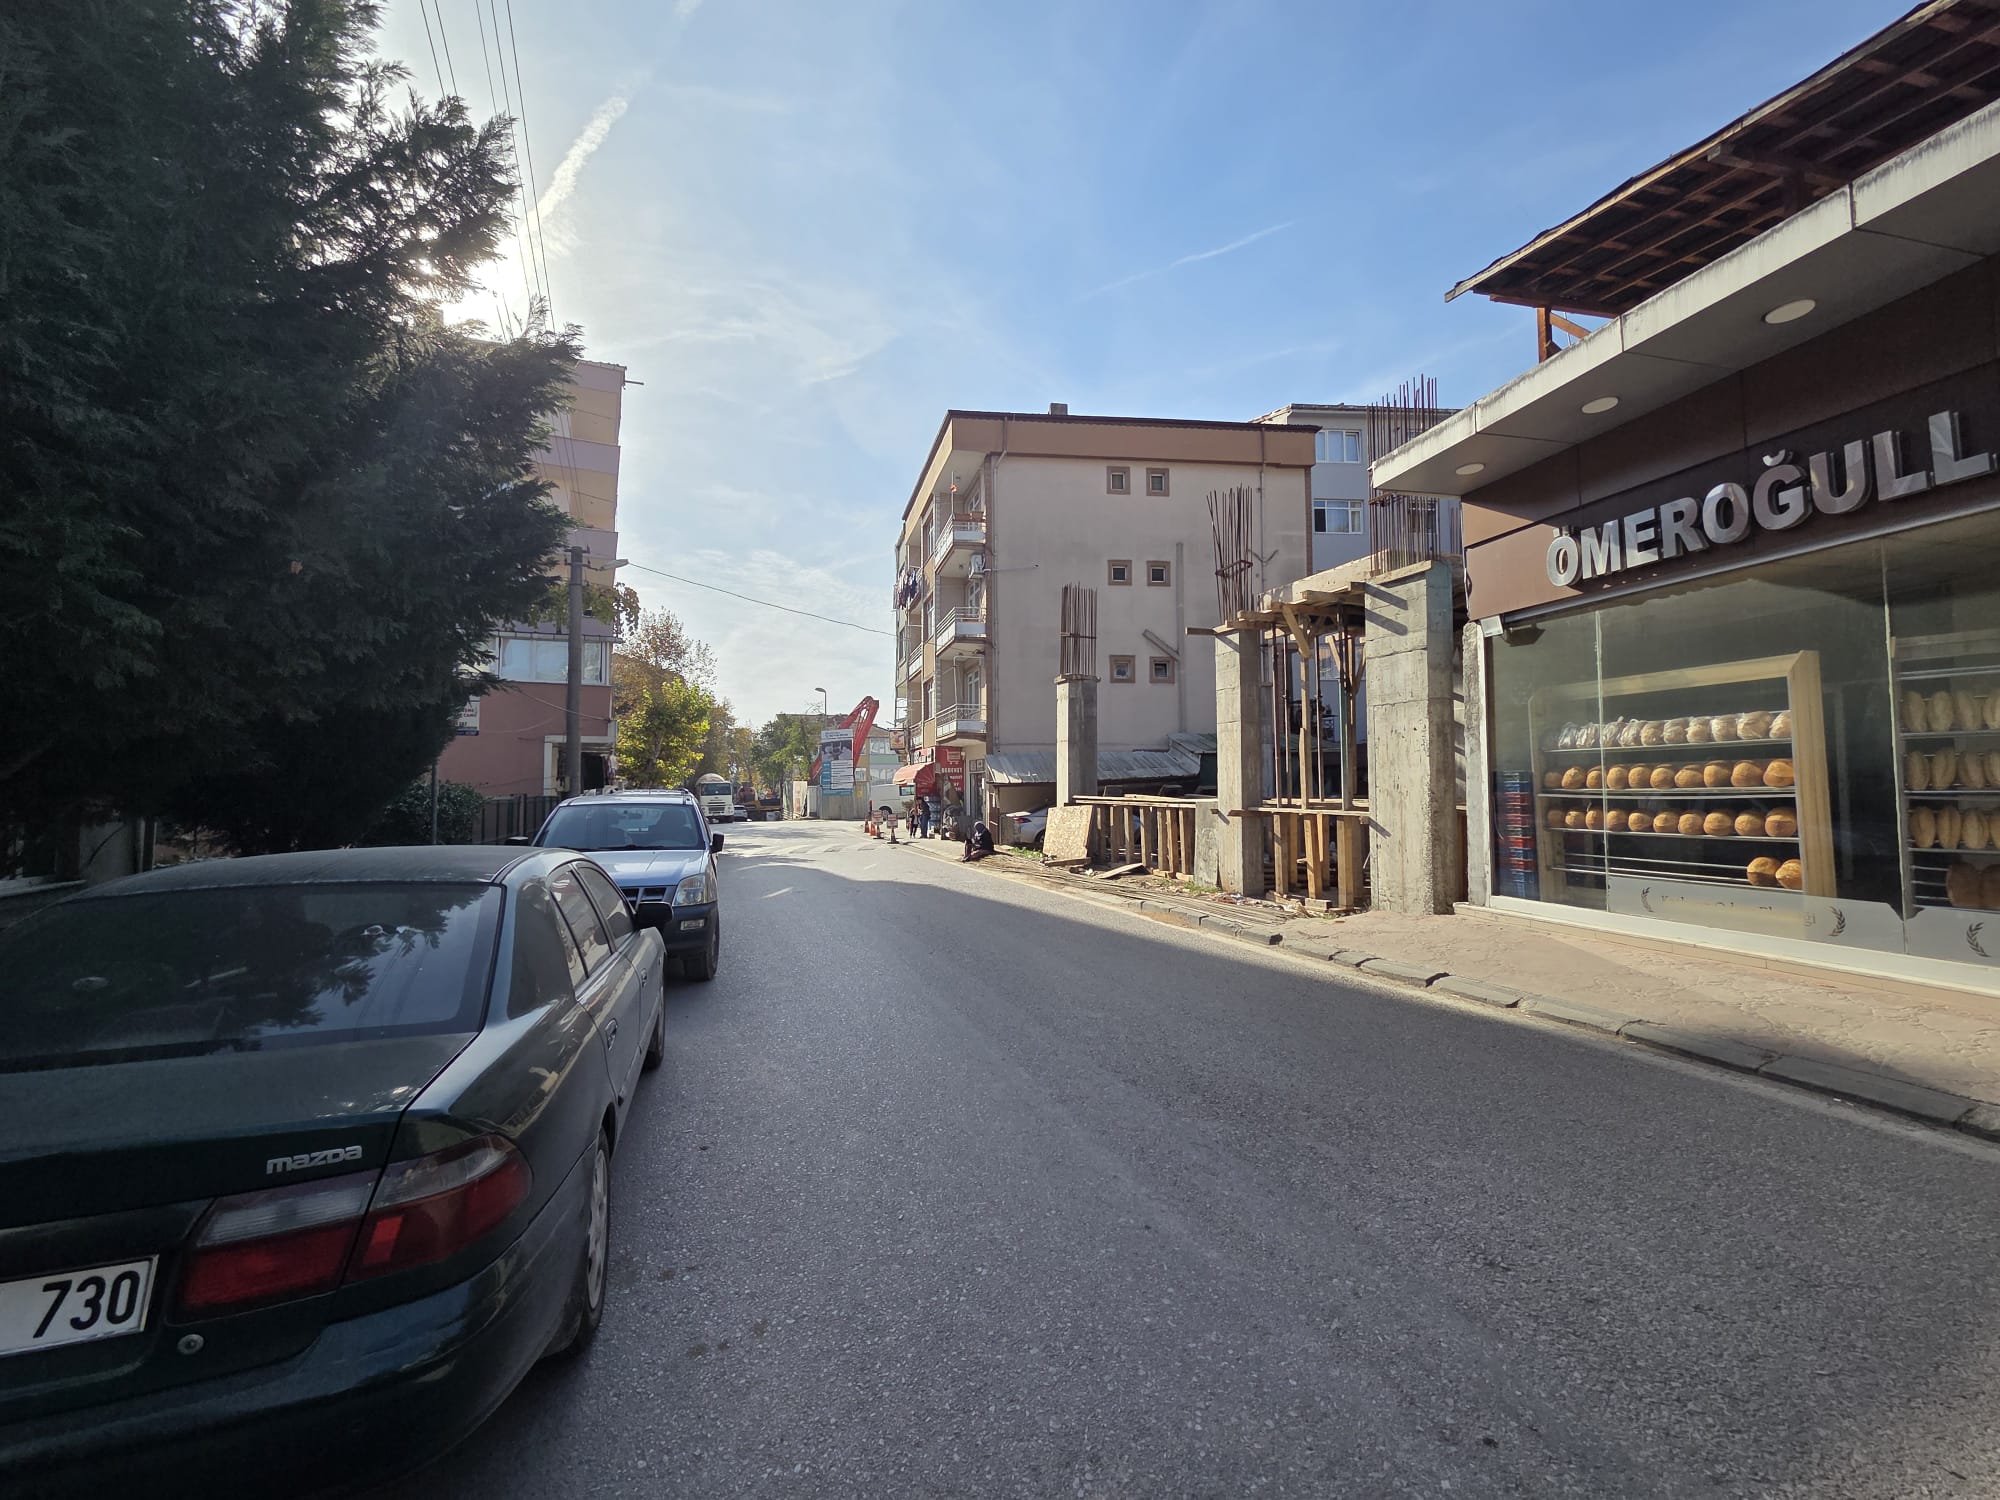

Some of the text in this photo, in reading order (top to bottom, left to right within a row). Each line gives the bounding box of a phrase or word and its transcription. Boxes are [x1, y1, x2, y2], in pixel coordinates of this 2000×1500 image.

[1546, 410, 1996, 587] ÖMEROĞULL
[265, 1145, 363, 1175] mazda
[32, 1270, 140, 1339] 730
